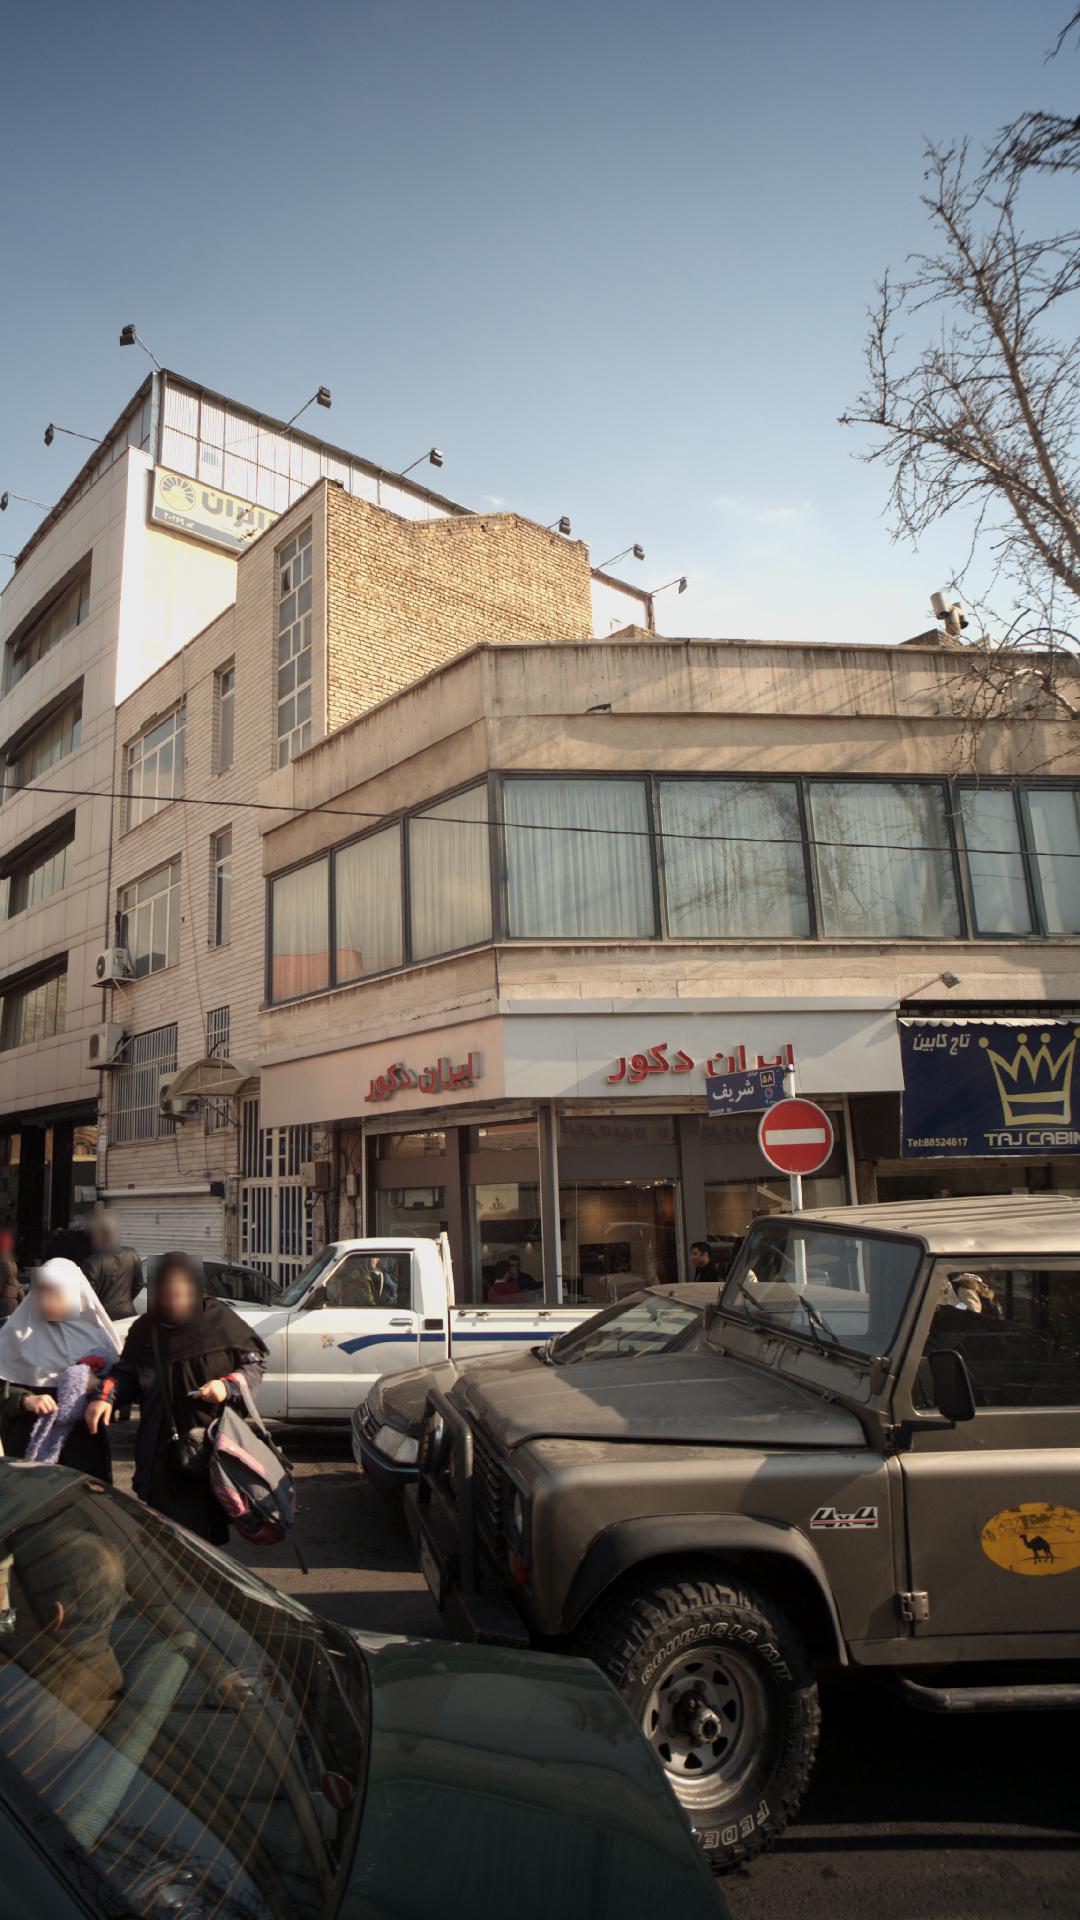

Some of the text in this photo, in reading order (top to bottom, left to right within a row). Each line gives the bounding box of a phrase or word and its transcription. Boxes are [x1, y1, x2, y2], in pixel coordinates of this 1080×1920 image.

[912, 1033, 971, 1056] تاج کابین
[607, 1043, 692, 1084] دکور
[364, 1051, 479, 1102] ایران دکور
[712, 1079, 755, 1103] شریف
[983, 1132, 1023, 1147] TAJ
[810, 1507, 879, 1529] 4x4
